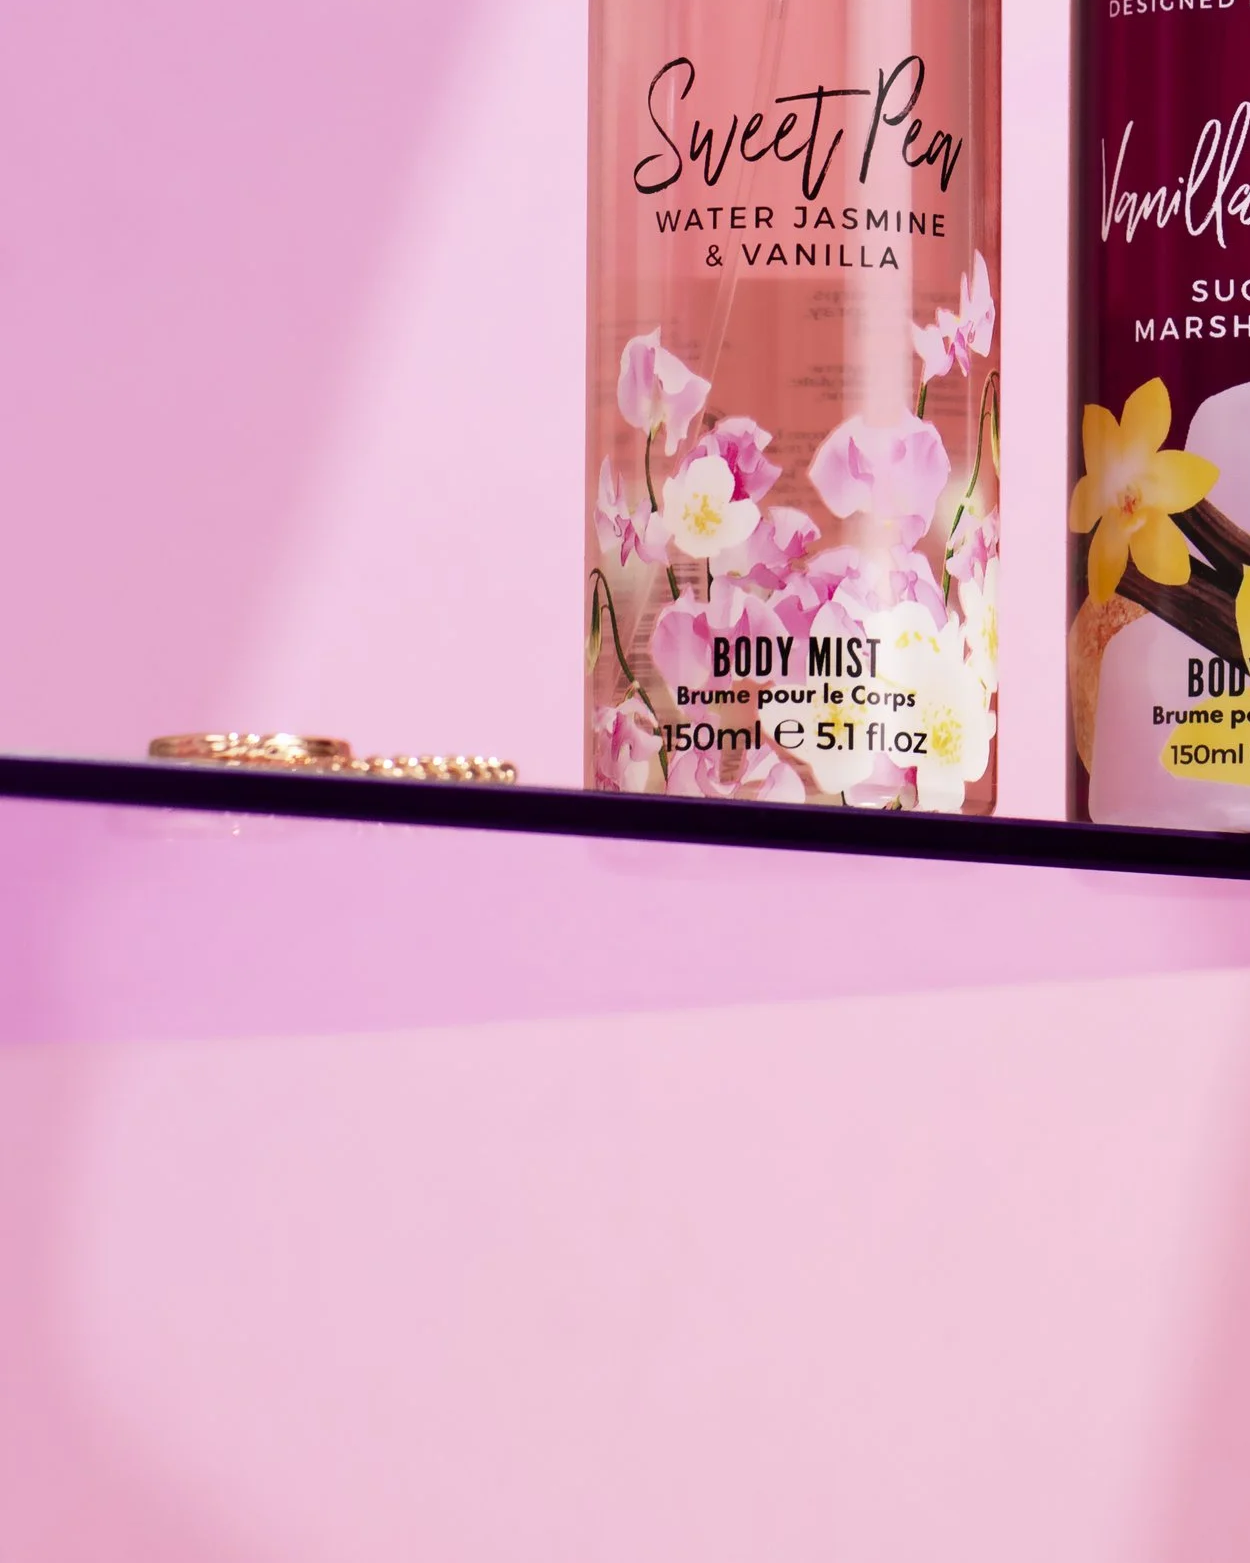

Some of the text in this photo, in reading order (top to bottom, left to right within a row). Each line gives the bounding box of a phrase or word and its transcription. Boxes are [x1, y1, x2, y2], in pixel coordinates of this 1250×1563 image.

[633, 55, 963, 200] Sweet Pea
[655, 205, 945, 238] WATER JASMINE
[706, 242, 899, 270] & VANILLA
[713, 636, 881, 679] BODY MIST
[677, 684, 916, 712] Brume pour le Corps
[1152, 706, 1224, 726] Brume
[663, 721, 761, 753] 150ml
[817, 723, 855, 752] 5.1
[865, 721, 928, 755] fl.oz
[1170, 744, 1244, 765] 150ml
